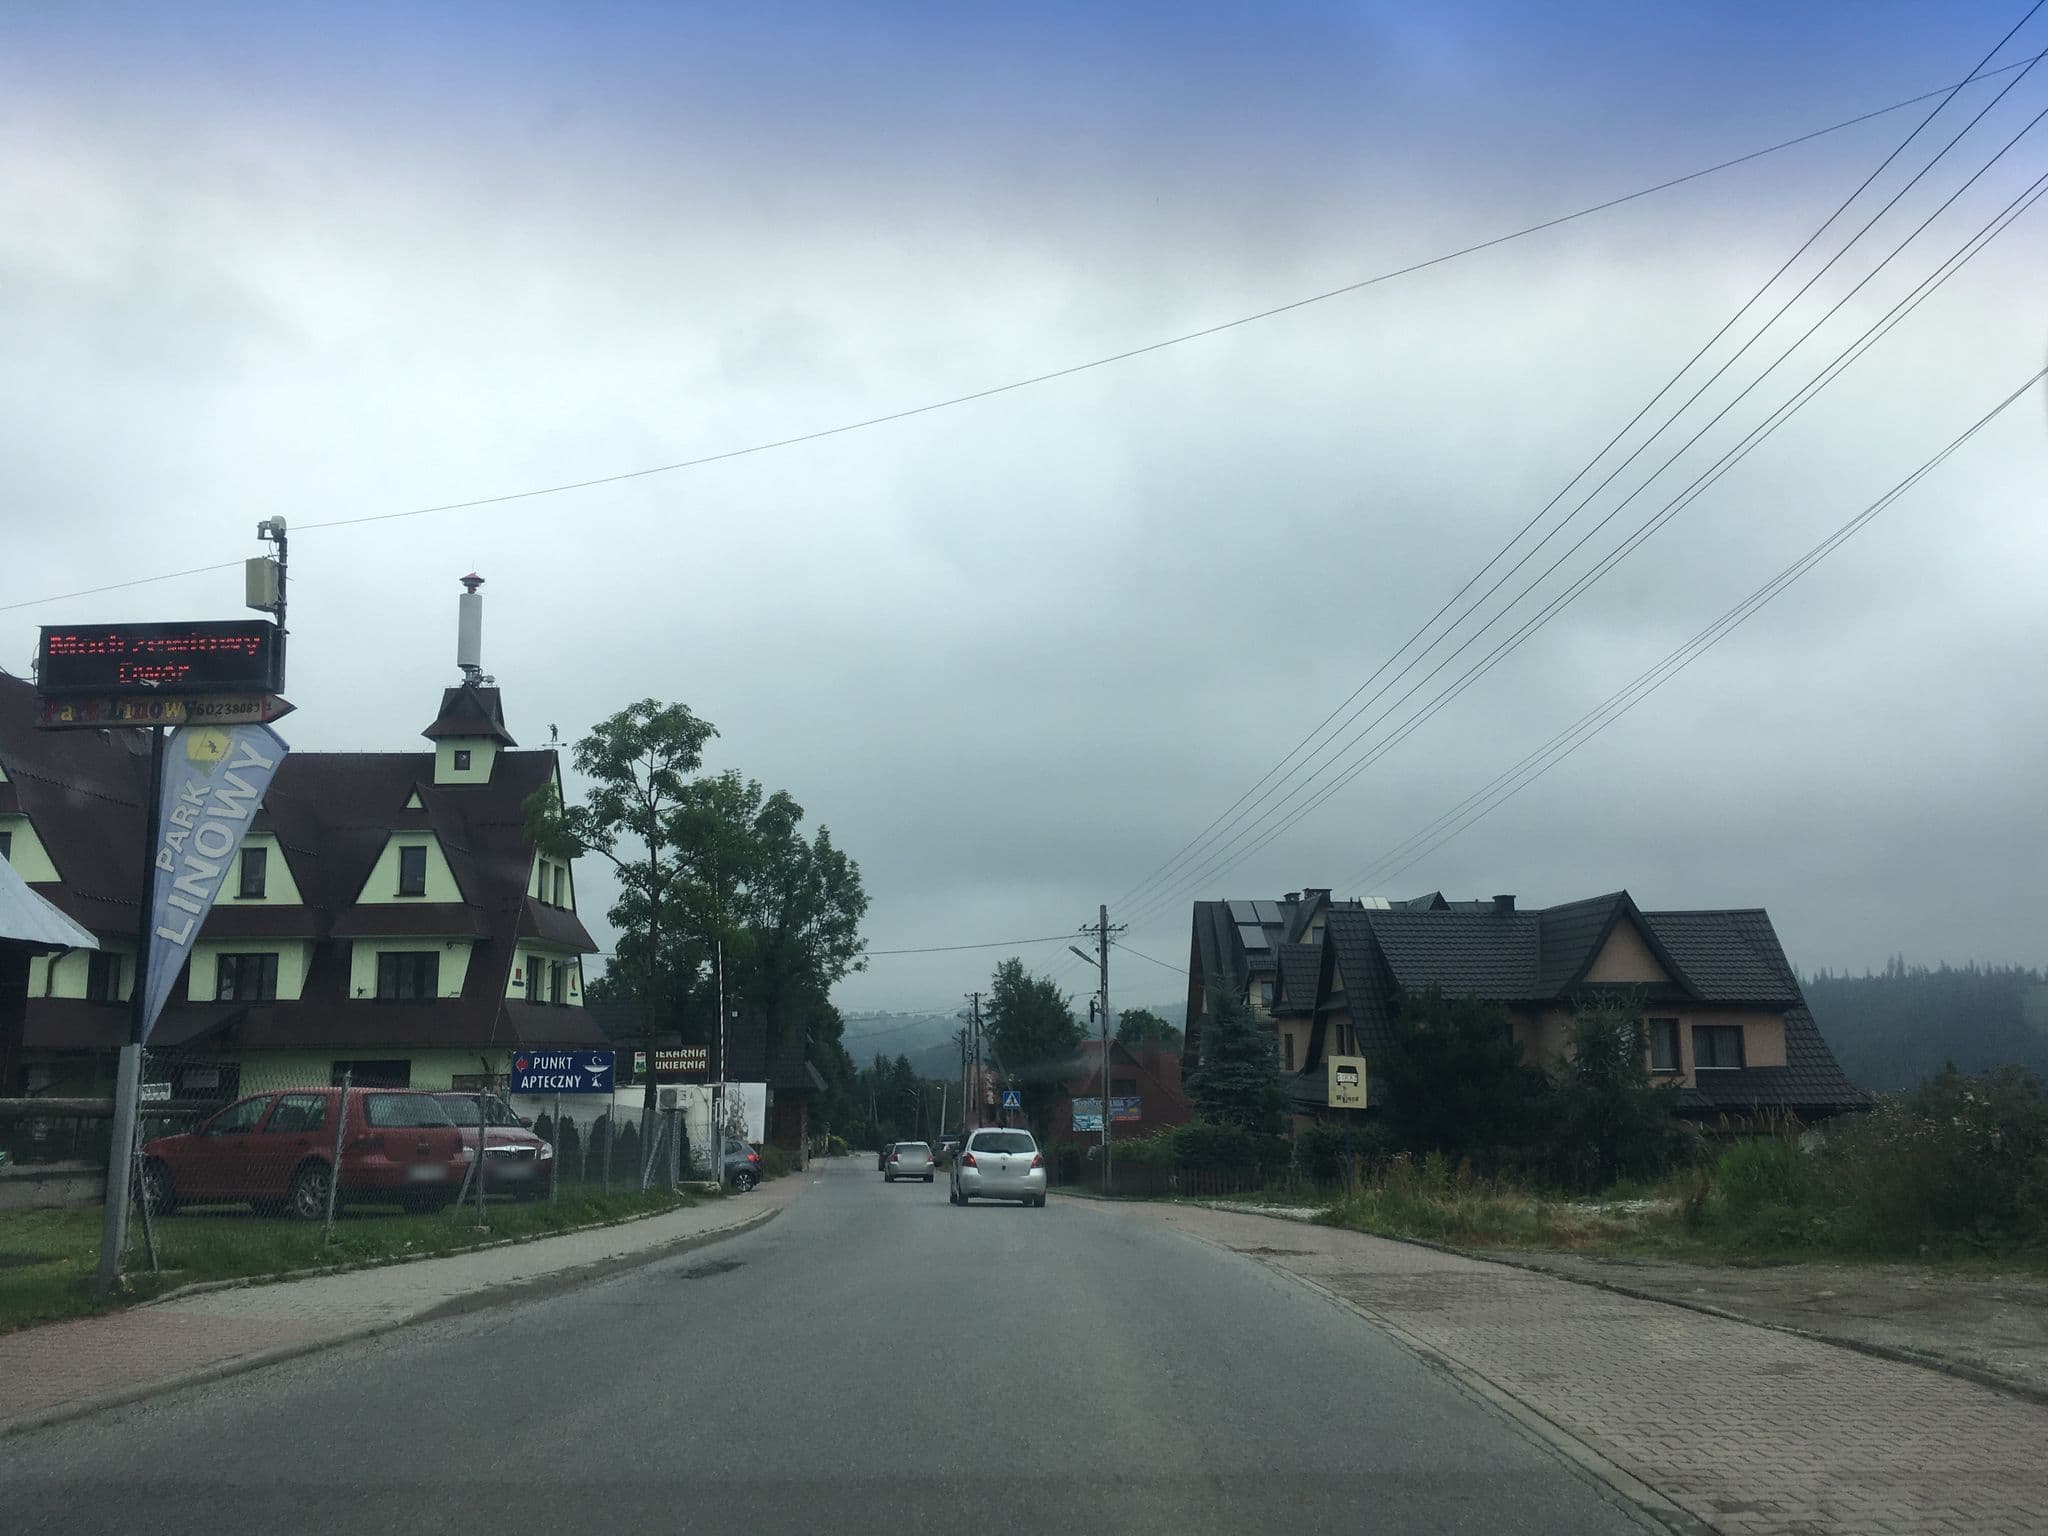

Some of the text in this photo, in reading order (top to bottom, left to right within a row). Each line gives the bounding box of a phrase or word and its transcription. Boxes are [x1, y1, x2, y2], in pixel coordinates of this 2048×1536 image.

[155, 779, 214, 873] PARK
[155, 740, 274, 946] LINOWY
[655, 1048, 708, 1058] IEKARNIA
[533, 1057, 573, 1070] PUNKT
[655, 1060, 706, 1070] UKIERNIA
[521, 1075, 582, 1089] APTECZNY
